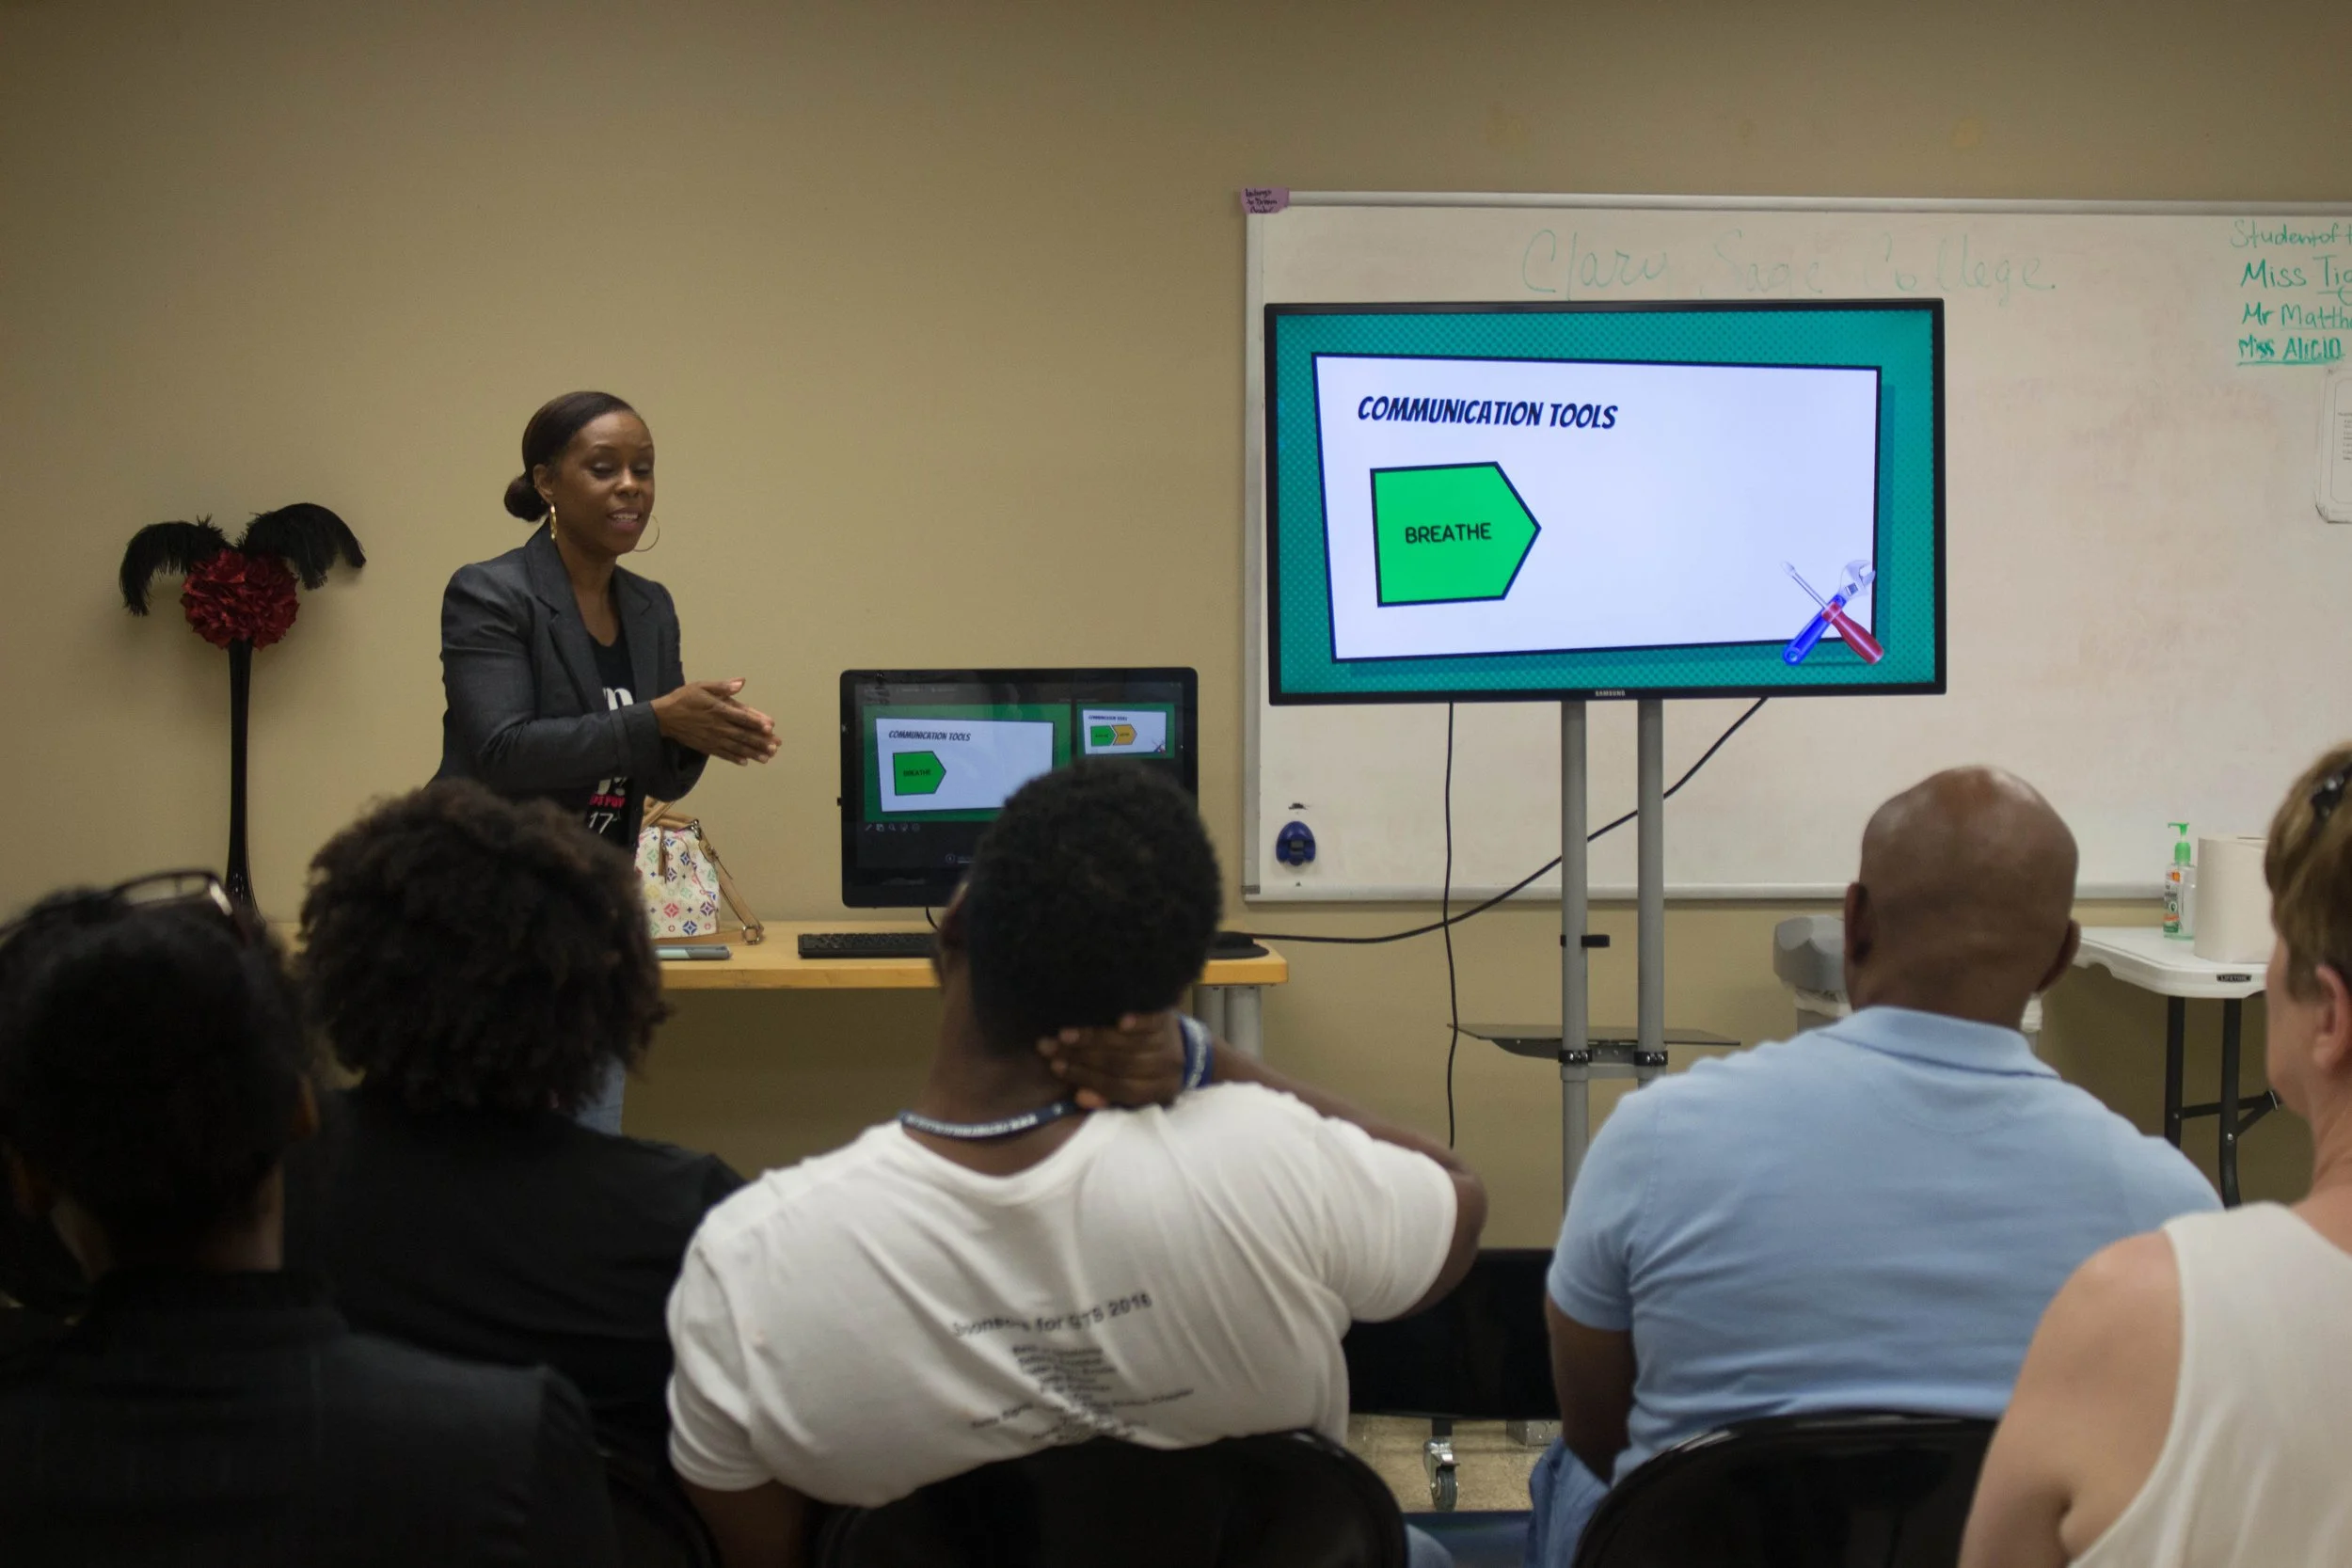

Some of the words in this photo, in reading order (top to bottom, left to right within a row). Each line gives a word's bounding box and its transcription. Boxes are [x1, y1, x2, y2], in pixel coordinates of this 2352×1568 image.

[2240, 258, 2309, 289] Miss
[2241, 301, 2275, 326] Mr
[1358, 395, 1544, 427] COMMUNICATION
[1549, 403, 1618, 430] TOOLS
[1405, 522, 1492, 545] BREATHE
[888, 730, 948, 741] COMMUNICATION
[948, 733, 971, 741] TOOLS
[1037, 1317, 1062, 1332] for
